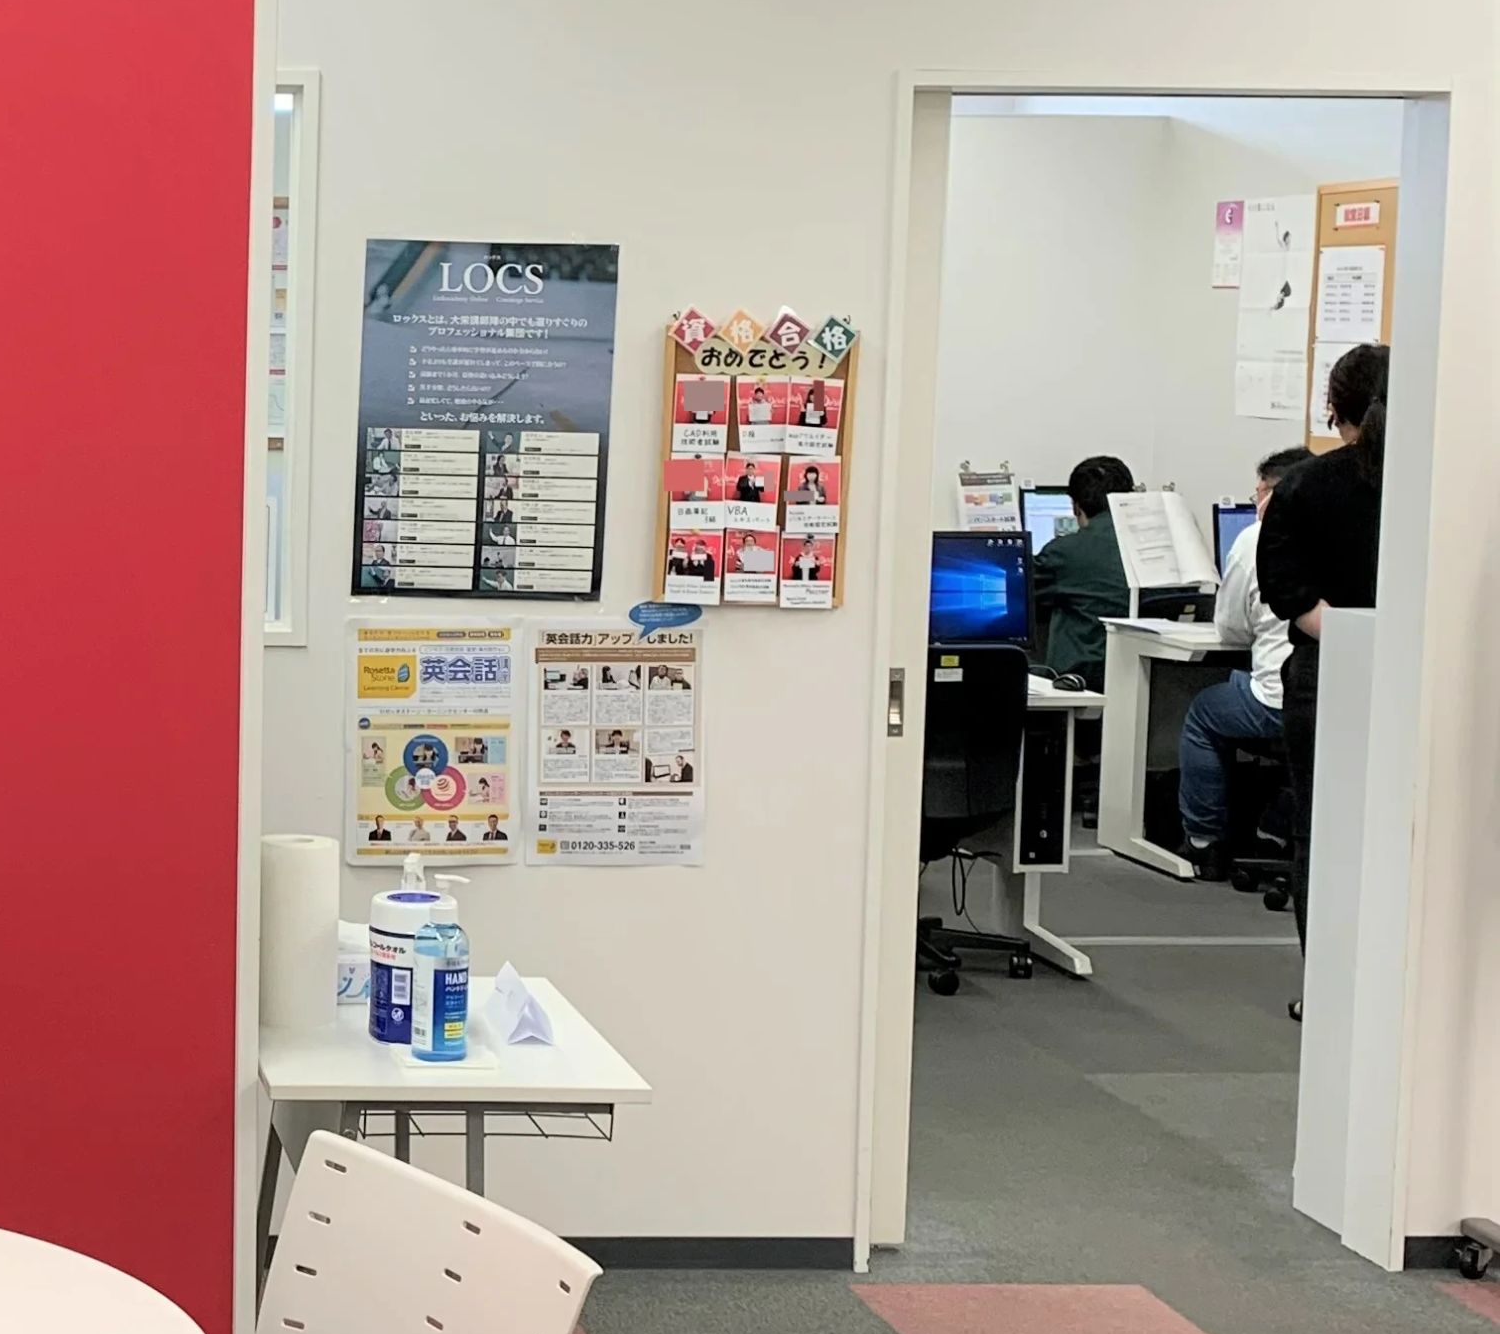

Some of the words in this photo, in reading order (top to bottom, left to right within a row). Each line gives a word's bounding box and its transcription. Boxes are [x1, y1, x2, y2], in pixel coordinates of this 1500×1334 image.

[439, 262, 544, 295] LOCS
[701, 346, 826, 371] おめでとう!
[727, 506, 748, 515] VBA
[363, 666, 396, 674] Rosetta
[421, 658, 498, 682] 英会話
[571, 841, 635, 850] 0120-335-526
